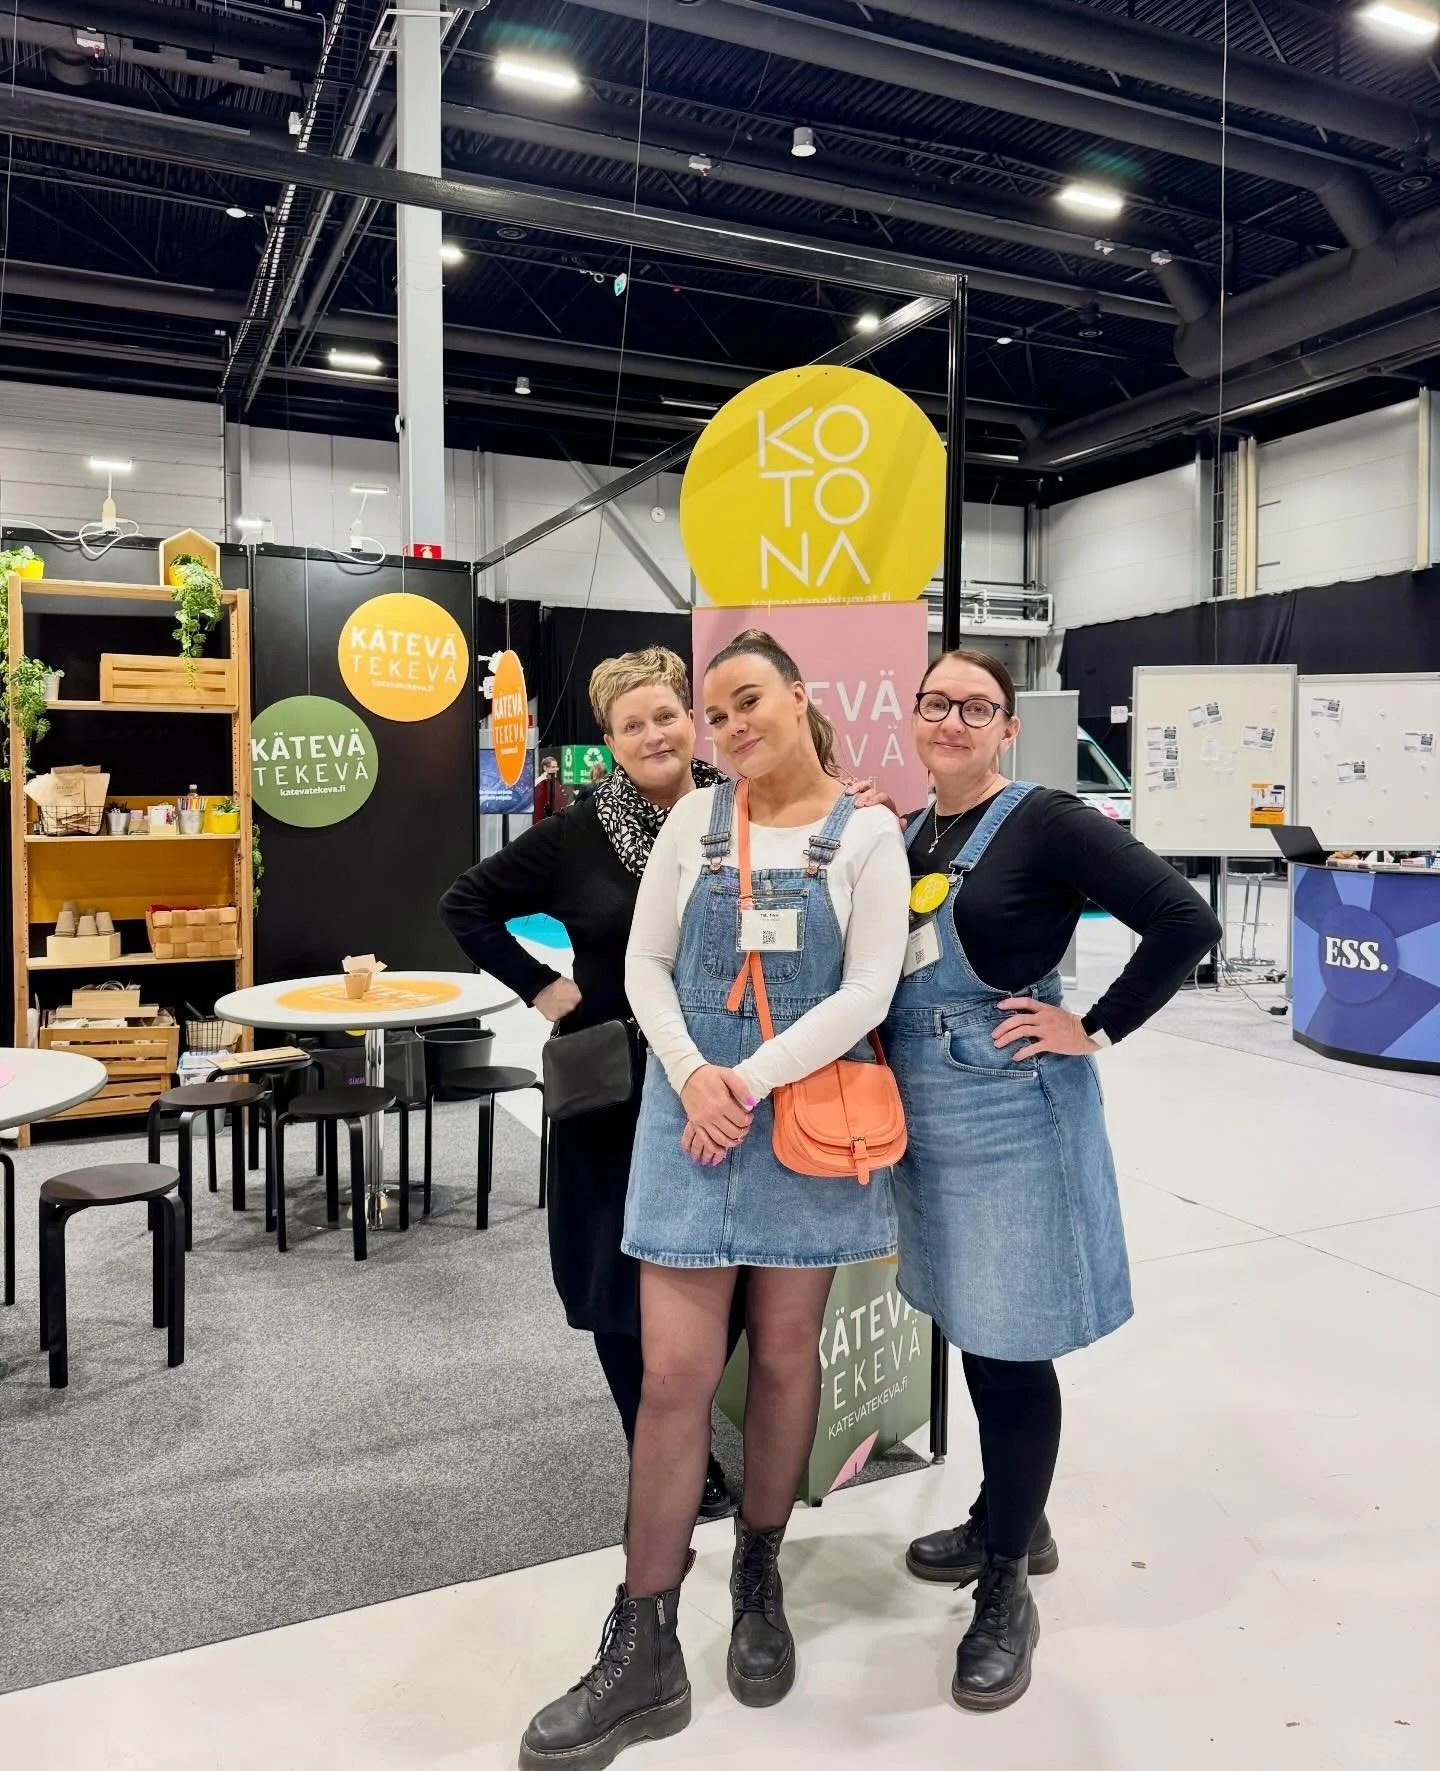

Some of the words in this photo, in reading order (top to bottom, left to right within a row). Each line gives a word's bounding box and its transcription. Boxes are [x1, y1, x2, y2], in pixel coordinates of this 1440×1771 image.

[350, 624, 459, 661] KÄTEVÄ
[351, 653, 458, 684] TEKEVÄ
[494, 686, 524, 720] KÄTEVÄ
[250, 728, 366, 762] KÄTEVÄ
[495, 716, 525, 744] TEKEVÄ
[253, 757, 369, 787] TEKEVÄ
[280, 784, 346, 797] katevatekeva.fi
[1324, 936, 1389, 972] ESS.
[821, 1318, 921, 1411] EKEVÄ
[827, 1376, 908, 1441] KATEVATEKEVA.fi
